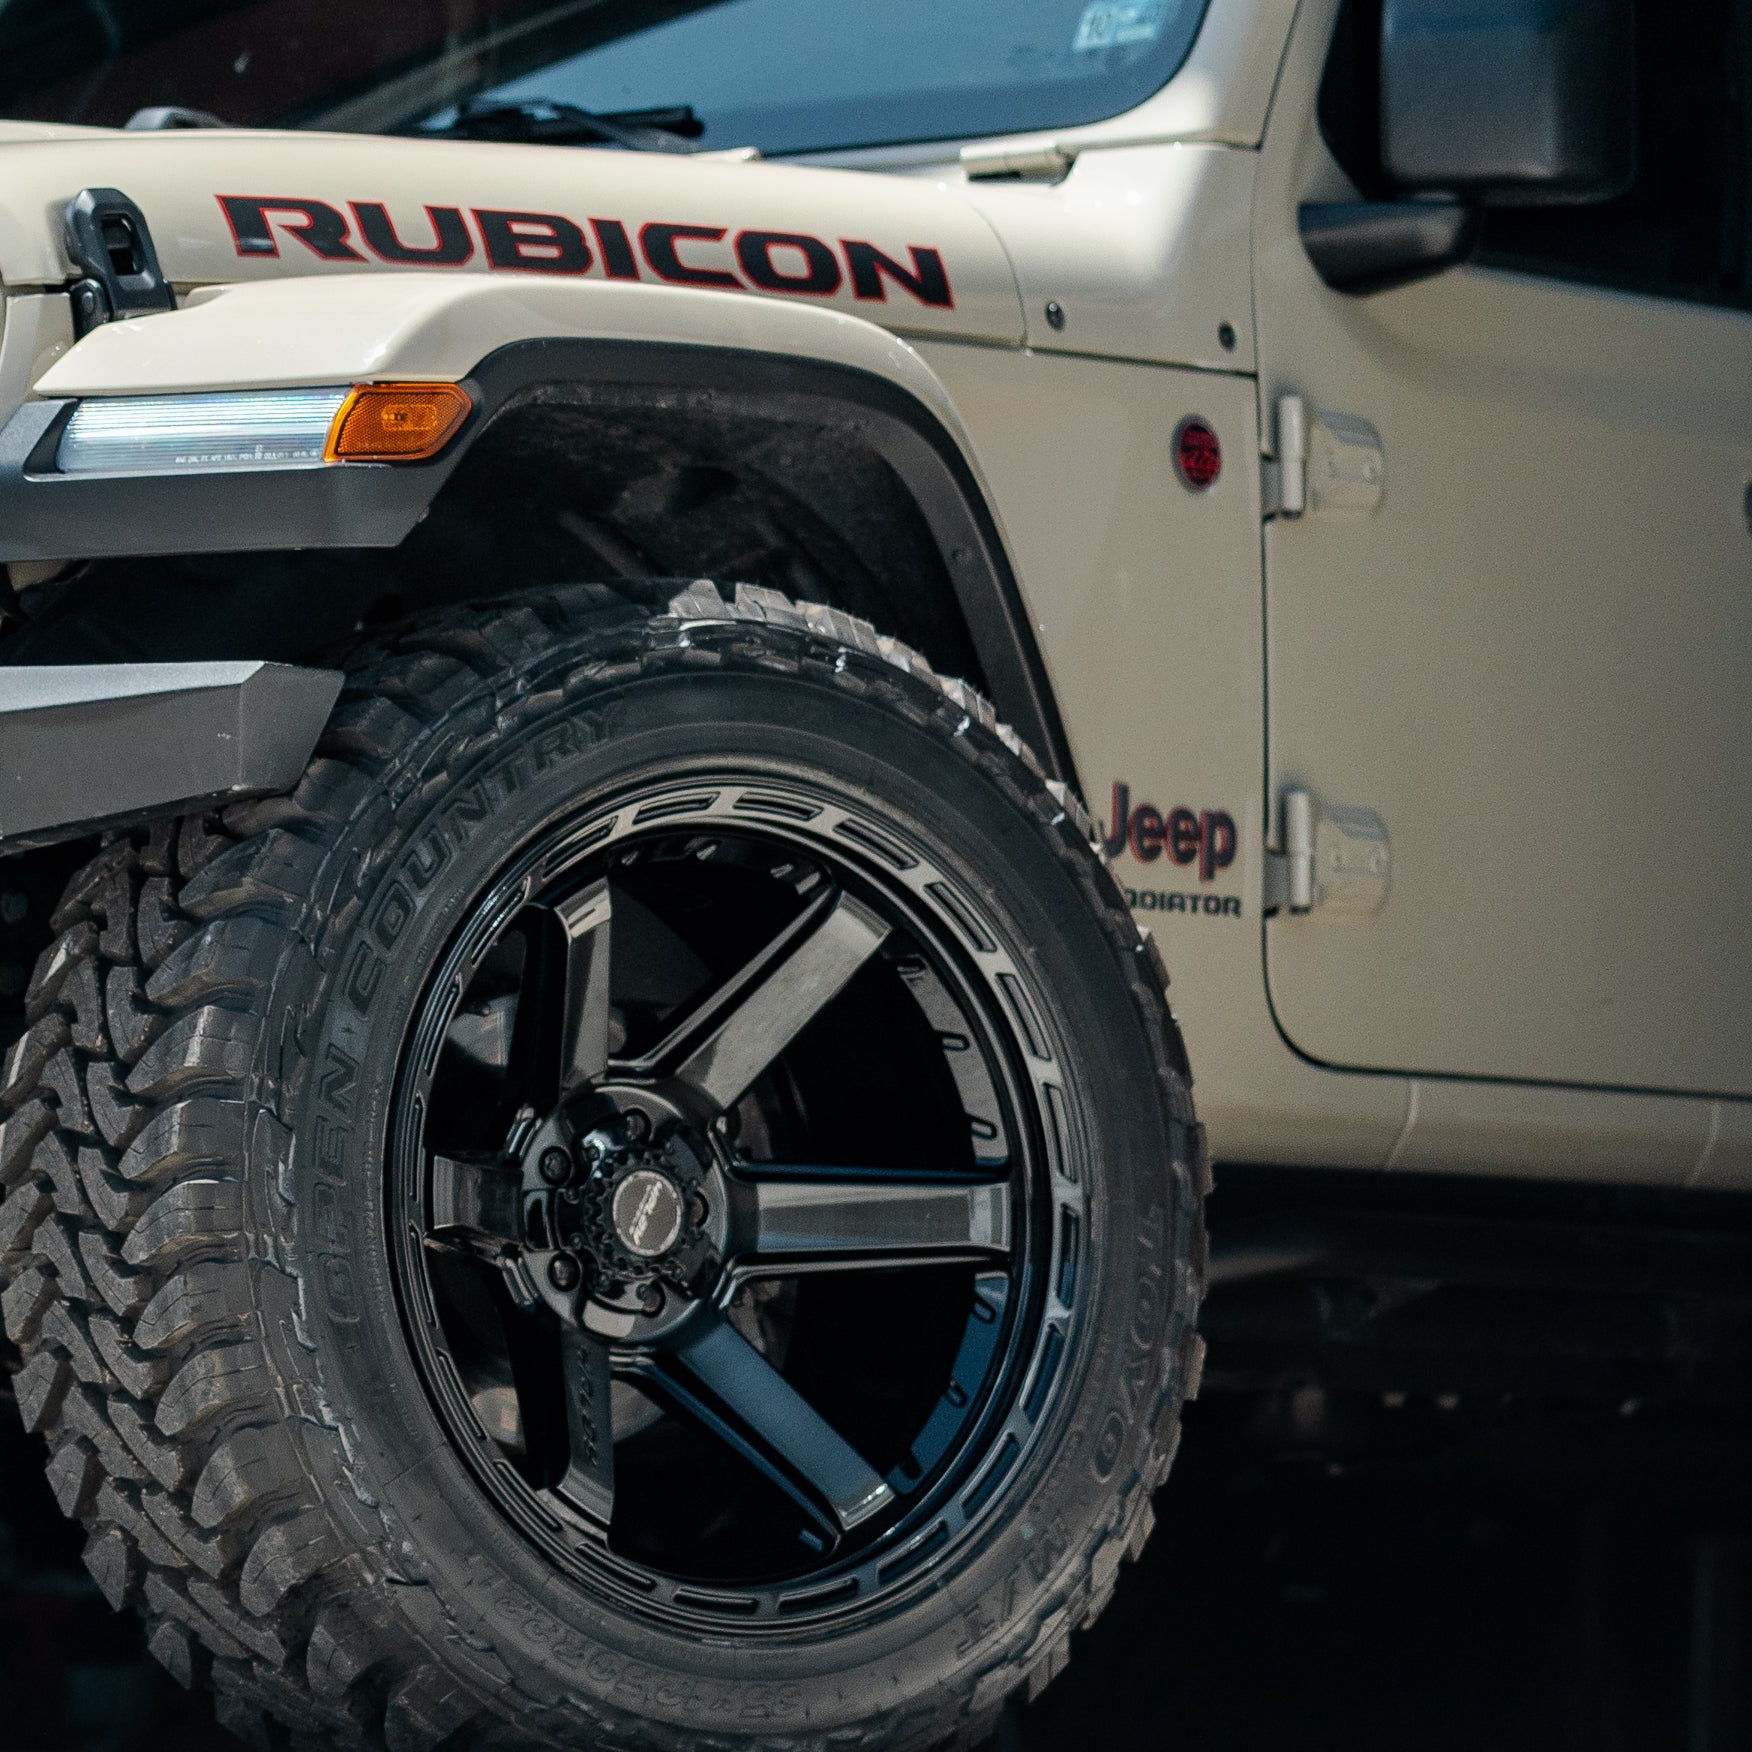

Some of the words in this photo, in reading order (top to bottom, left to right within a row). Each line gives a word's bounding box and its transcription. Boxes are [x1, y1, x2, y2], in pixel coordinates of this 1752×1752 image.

[214, 194, 954, 310] RUBICON
[1103, 779, 1238, 882] Jeep
[304, 1041, 362, 1325] OPEN
[344, 698, 614, 1025] COUNTRY
